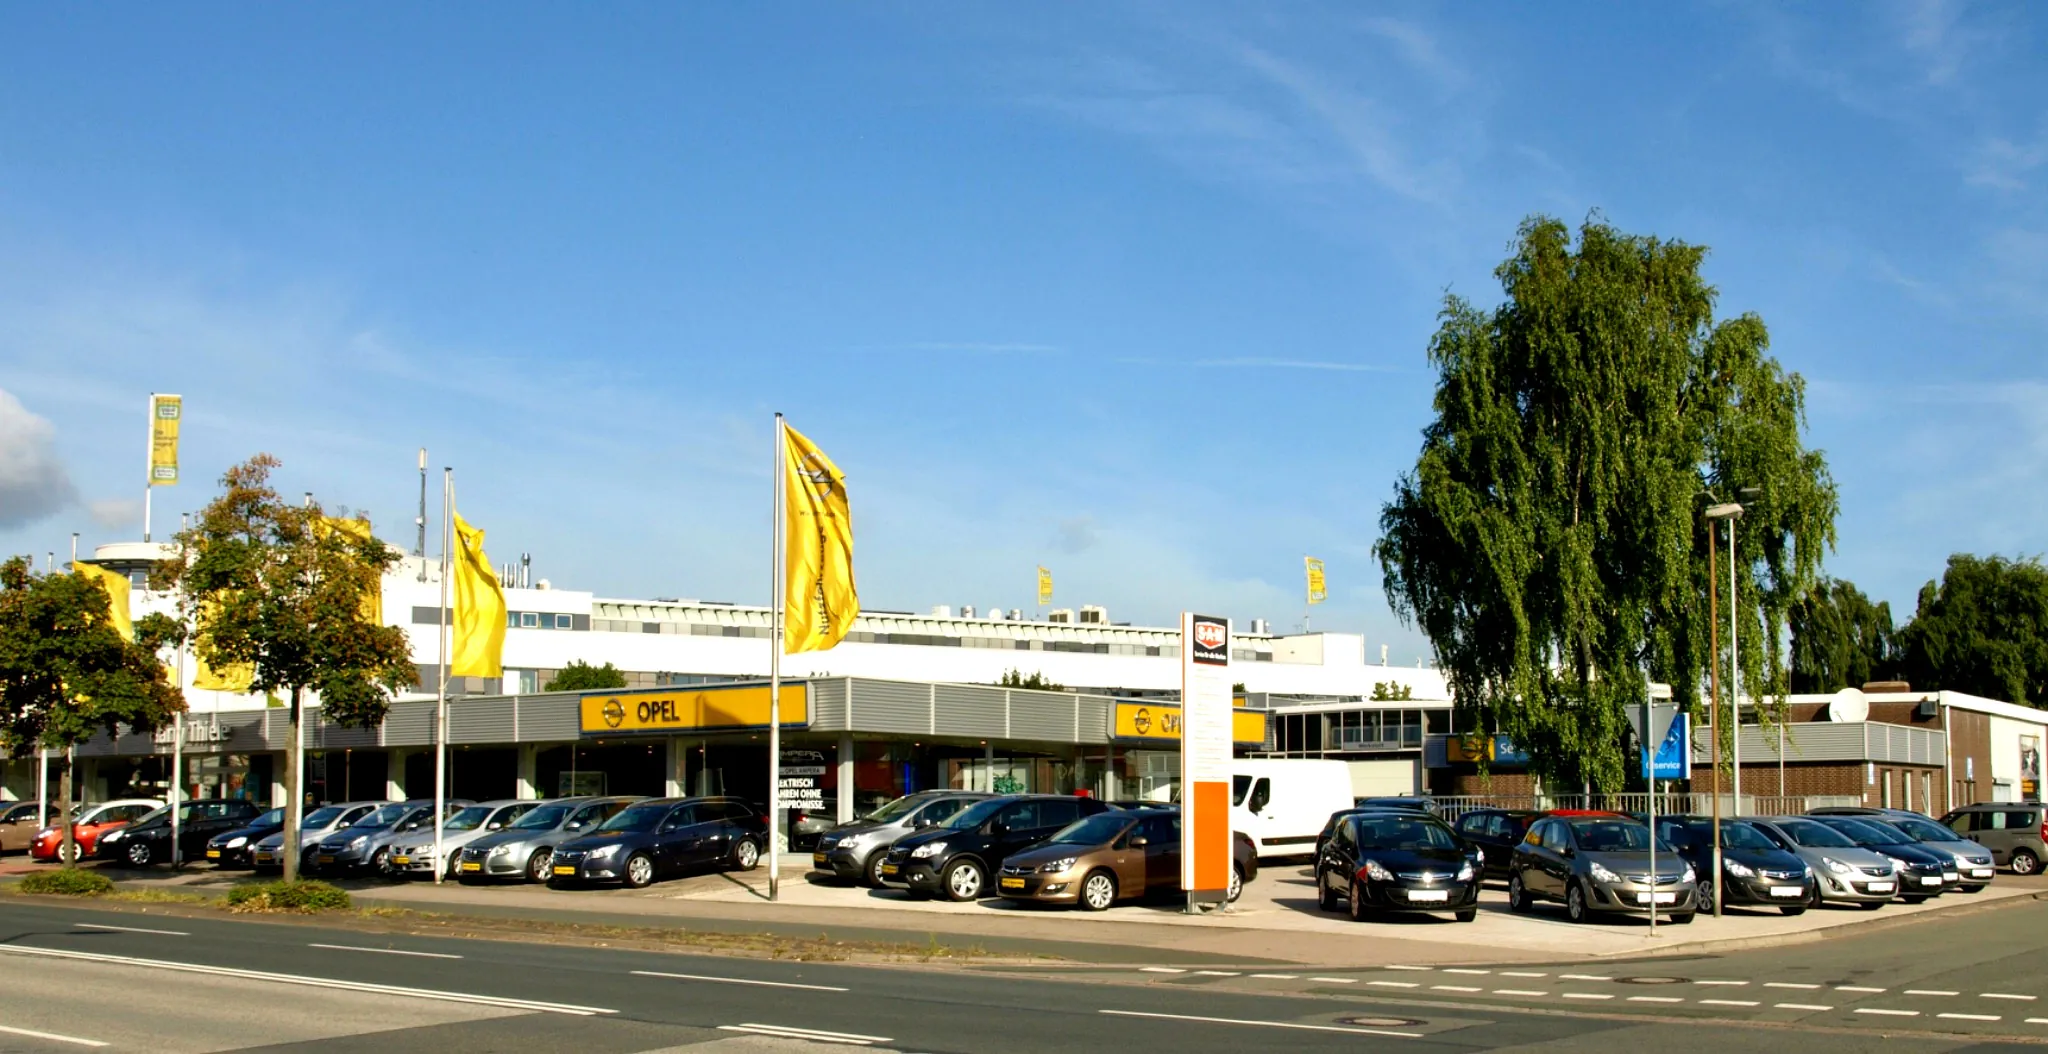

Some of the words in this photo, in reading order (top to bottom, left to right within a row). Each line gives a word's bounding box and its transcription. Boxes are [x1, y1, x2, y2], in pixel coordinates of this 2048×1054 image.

[637, 700, 681, 724] OPEL
[188, 719, 230, 741] Thiele
[1161, 713, 1181, 733] OP
[779, 777, 814, 788] EKTRISCH
[778, 789, 799, 798] AHREN
[800, 789, 822, 798] OHNE
[778, 800, 826, 809] OMPROMISSE.
